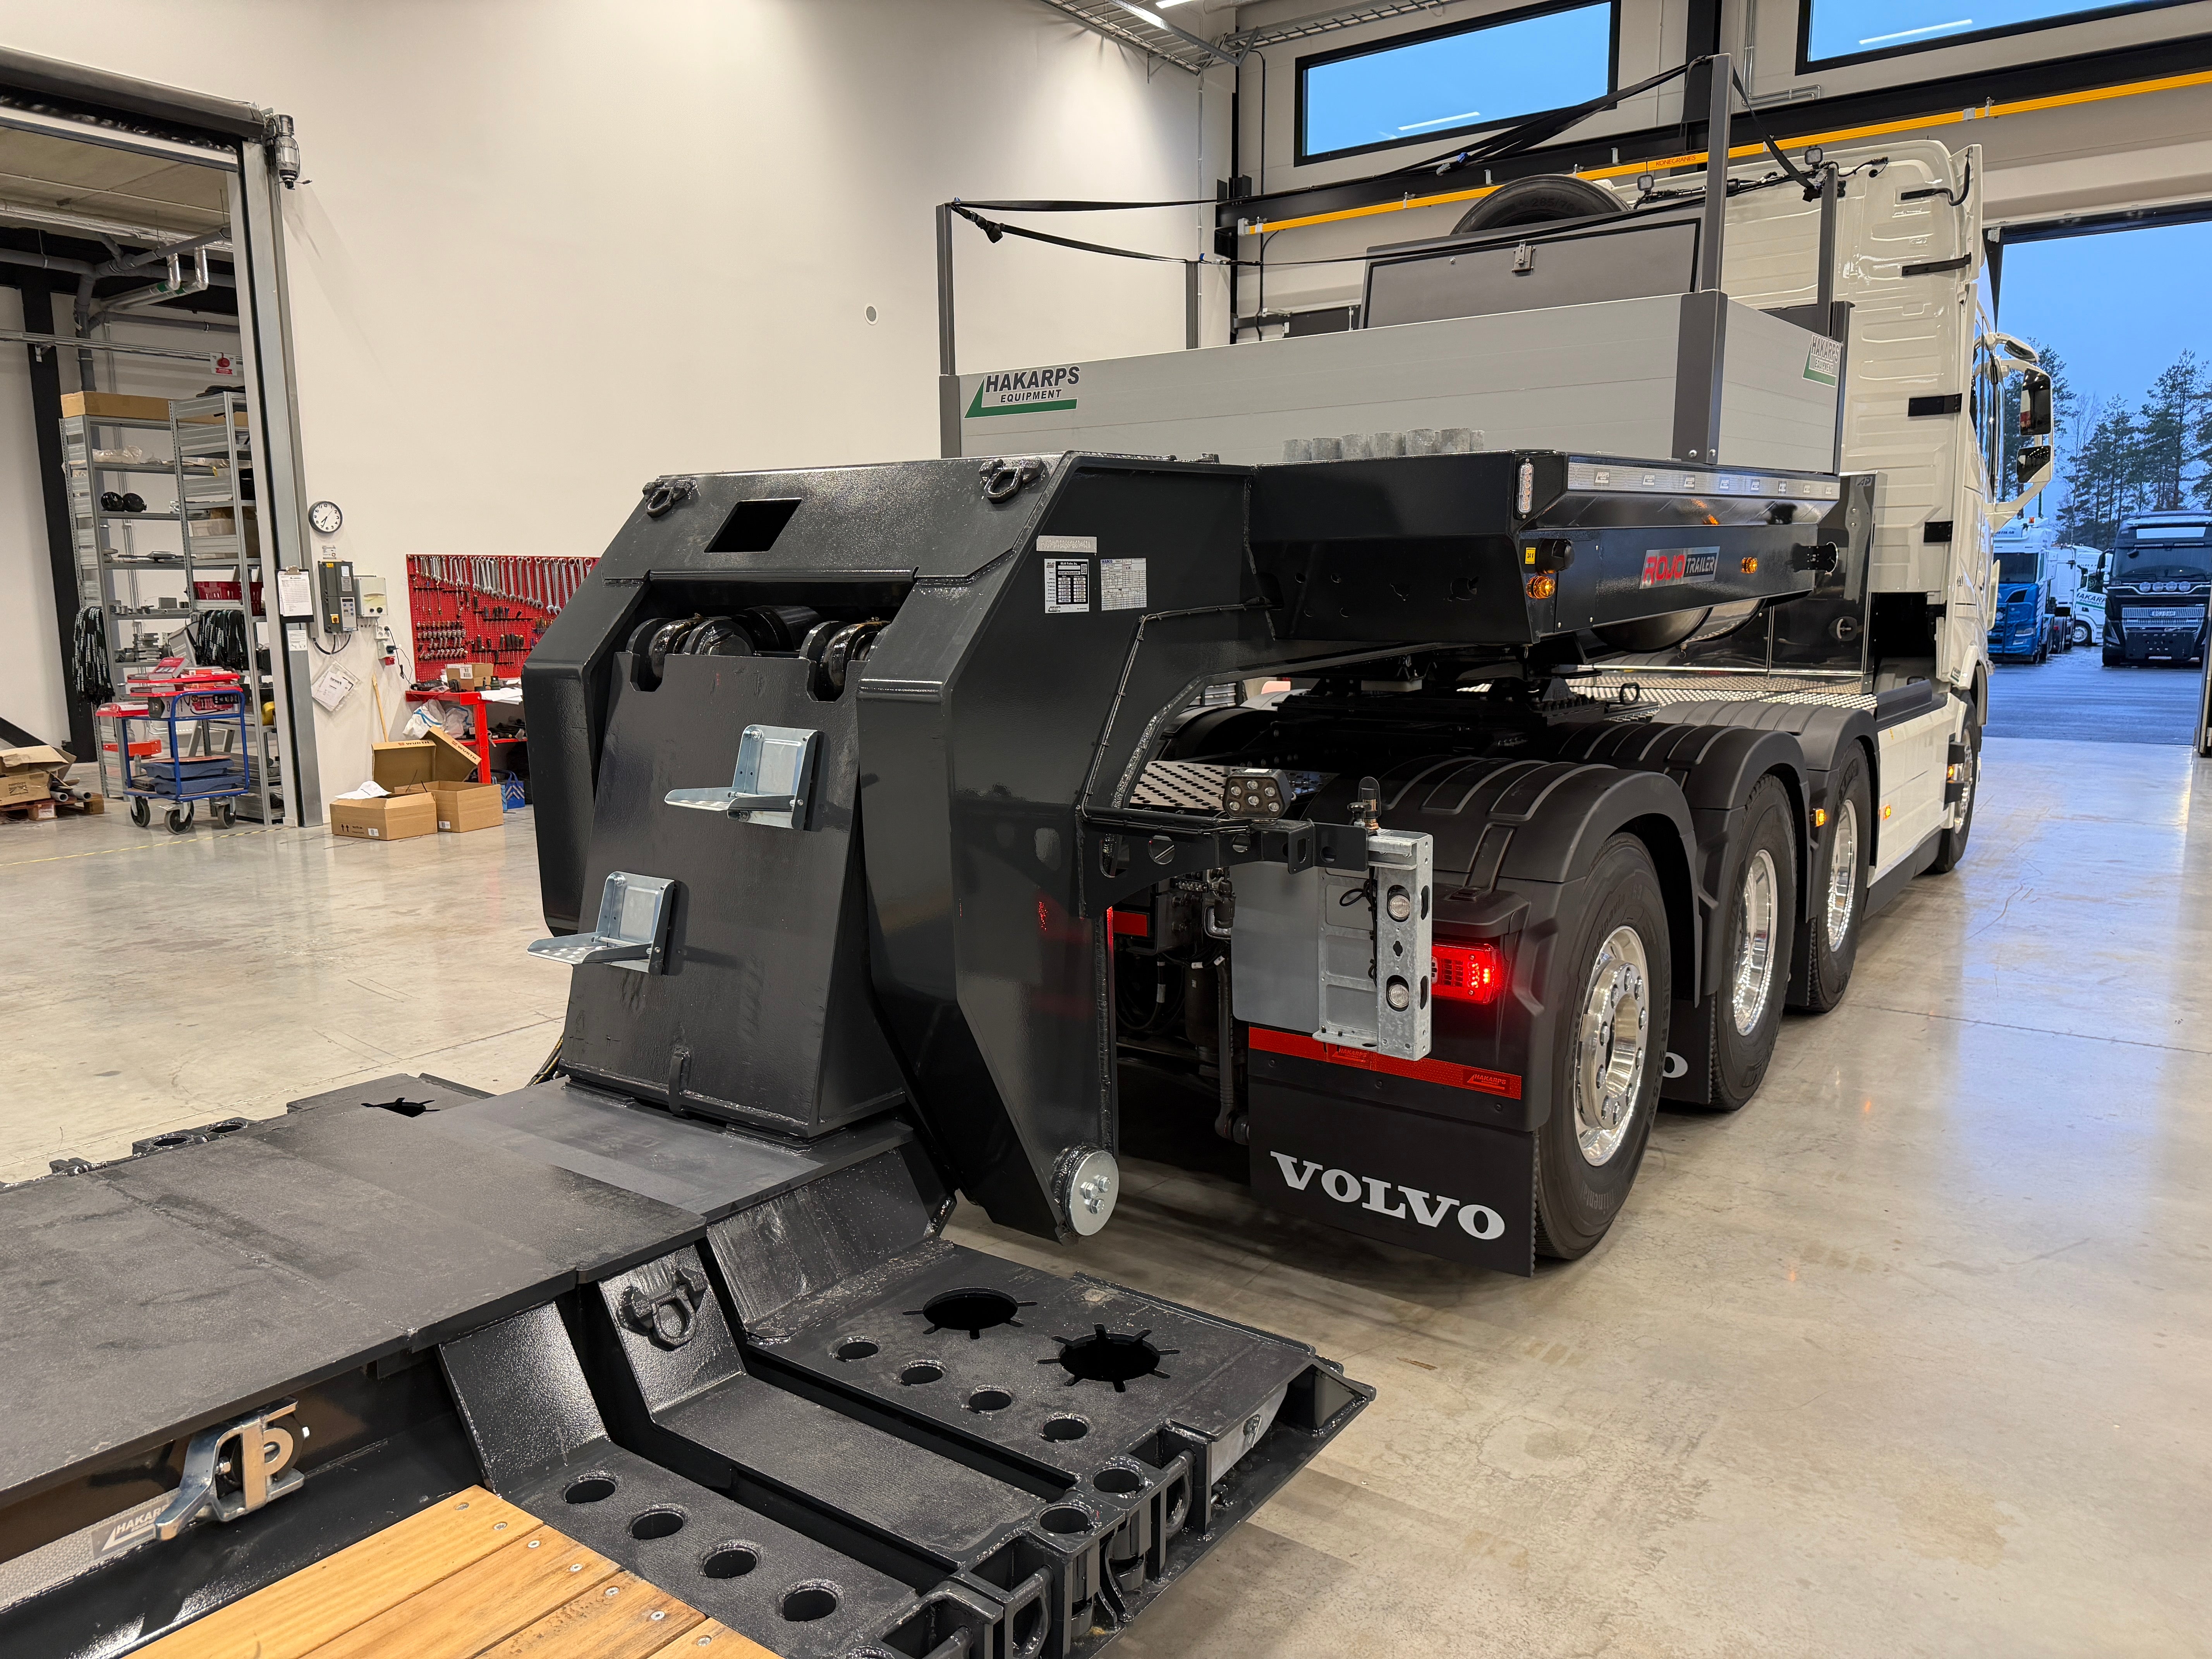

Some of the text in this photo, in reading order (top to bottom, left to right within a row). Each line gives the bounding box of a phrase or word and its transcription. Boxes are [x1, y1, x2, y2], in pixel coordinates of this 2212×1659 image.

[1656, 155, 1696, 166] KONECRANES
[1811, 335, 1839, 362] HAKARPS
[986, 366, 1080, 393] HAKARPS
[1000, 389, 1062, 403] EQUIPMENT
[1643, 555, 1715, 585] ROJO TRAILER
[1339, 1048, 1367, 1058] HAKARPS
[1475, 1074, 1506, 1084] HAKARPS
[1271, 1151, 1505, 1240] VOLVO
